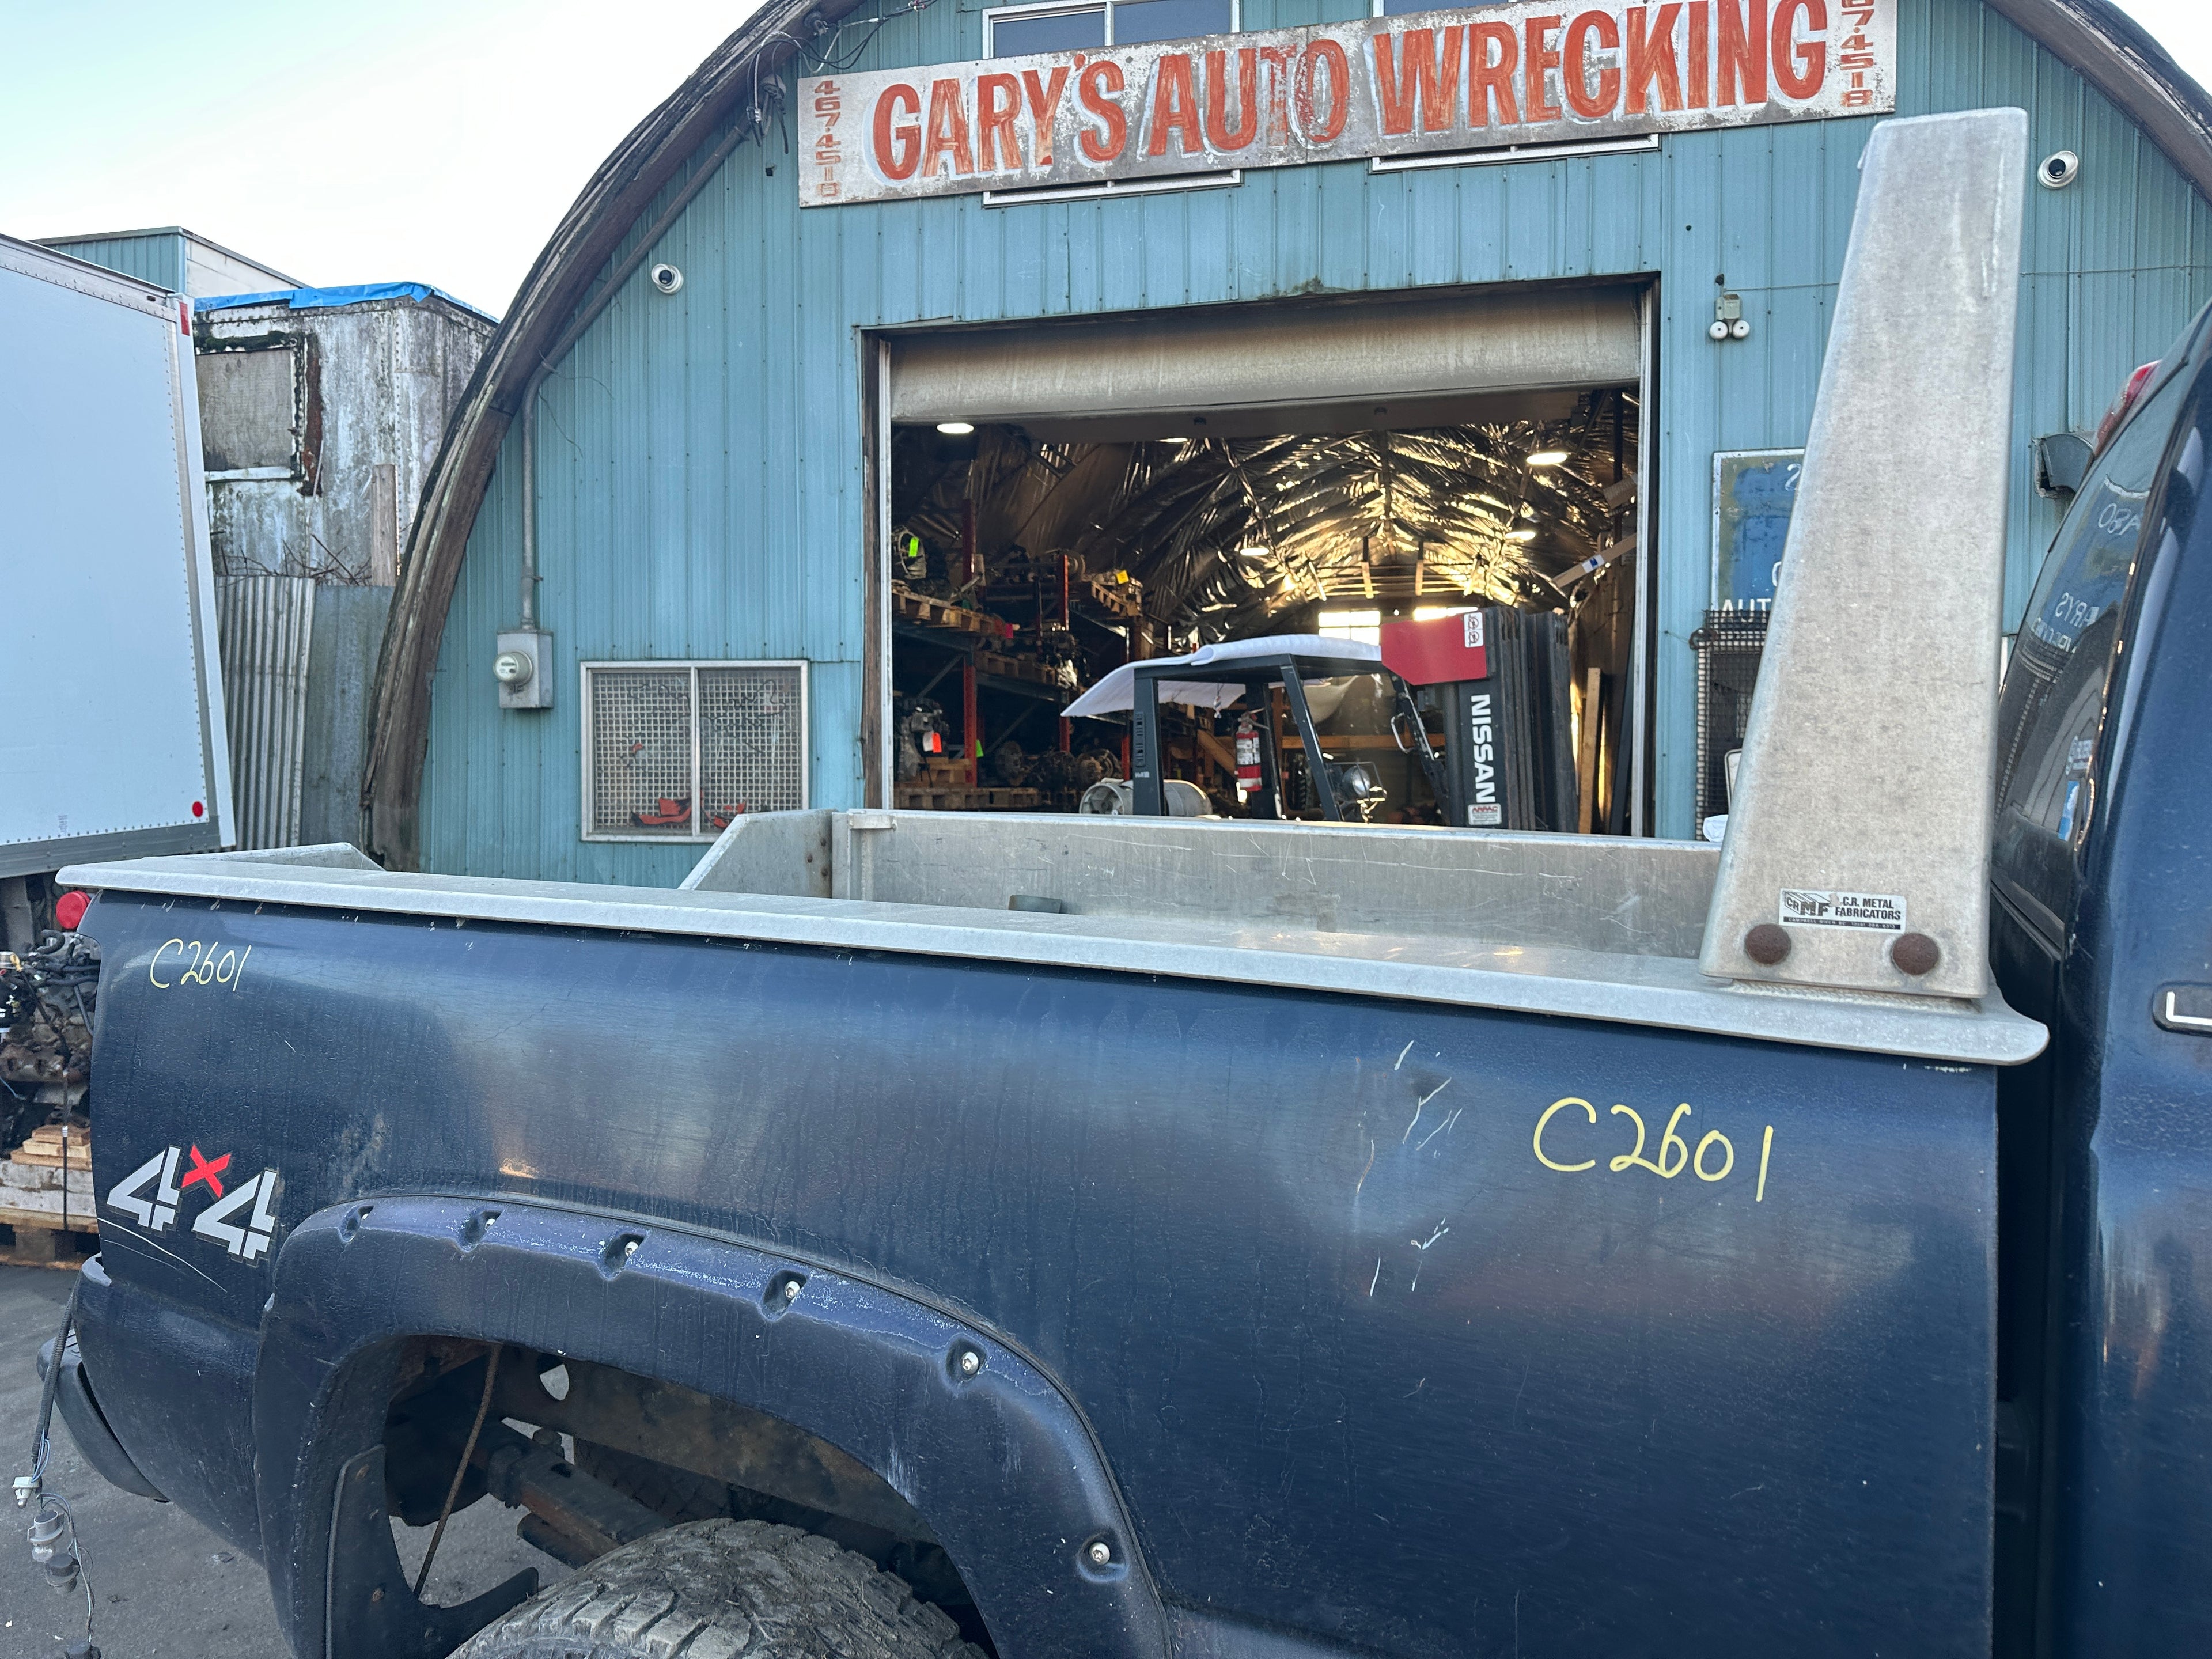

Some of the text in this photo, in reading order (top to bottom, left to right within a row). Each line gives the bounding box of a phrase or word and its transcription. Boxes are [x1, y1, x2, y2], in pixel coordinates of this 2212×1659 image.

[871, 0, 1827, 181] GARY'S AUTO WRECKING
[1721, 598, 1772, 623] AUT
[1470, 694, 1497, 804] NISSAN
[1835, 907, 1901, 921] FABRICATORS
[1862, 897, 1895, 910] METAL
[150, 938, 252, 992] C2601
[1533, 1097, 1774, 1203] C2601
